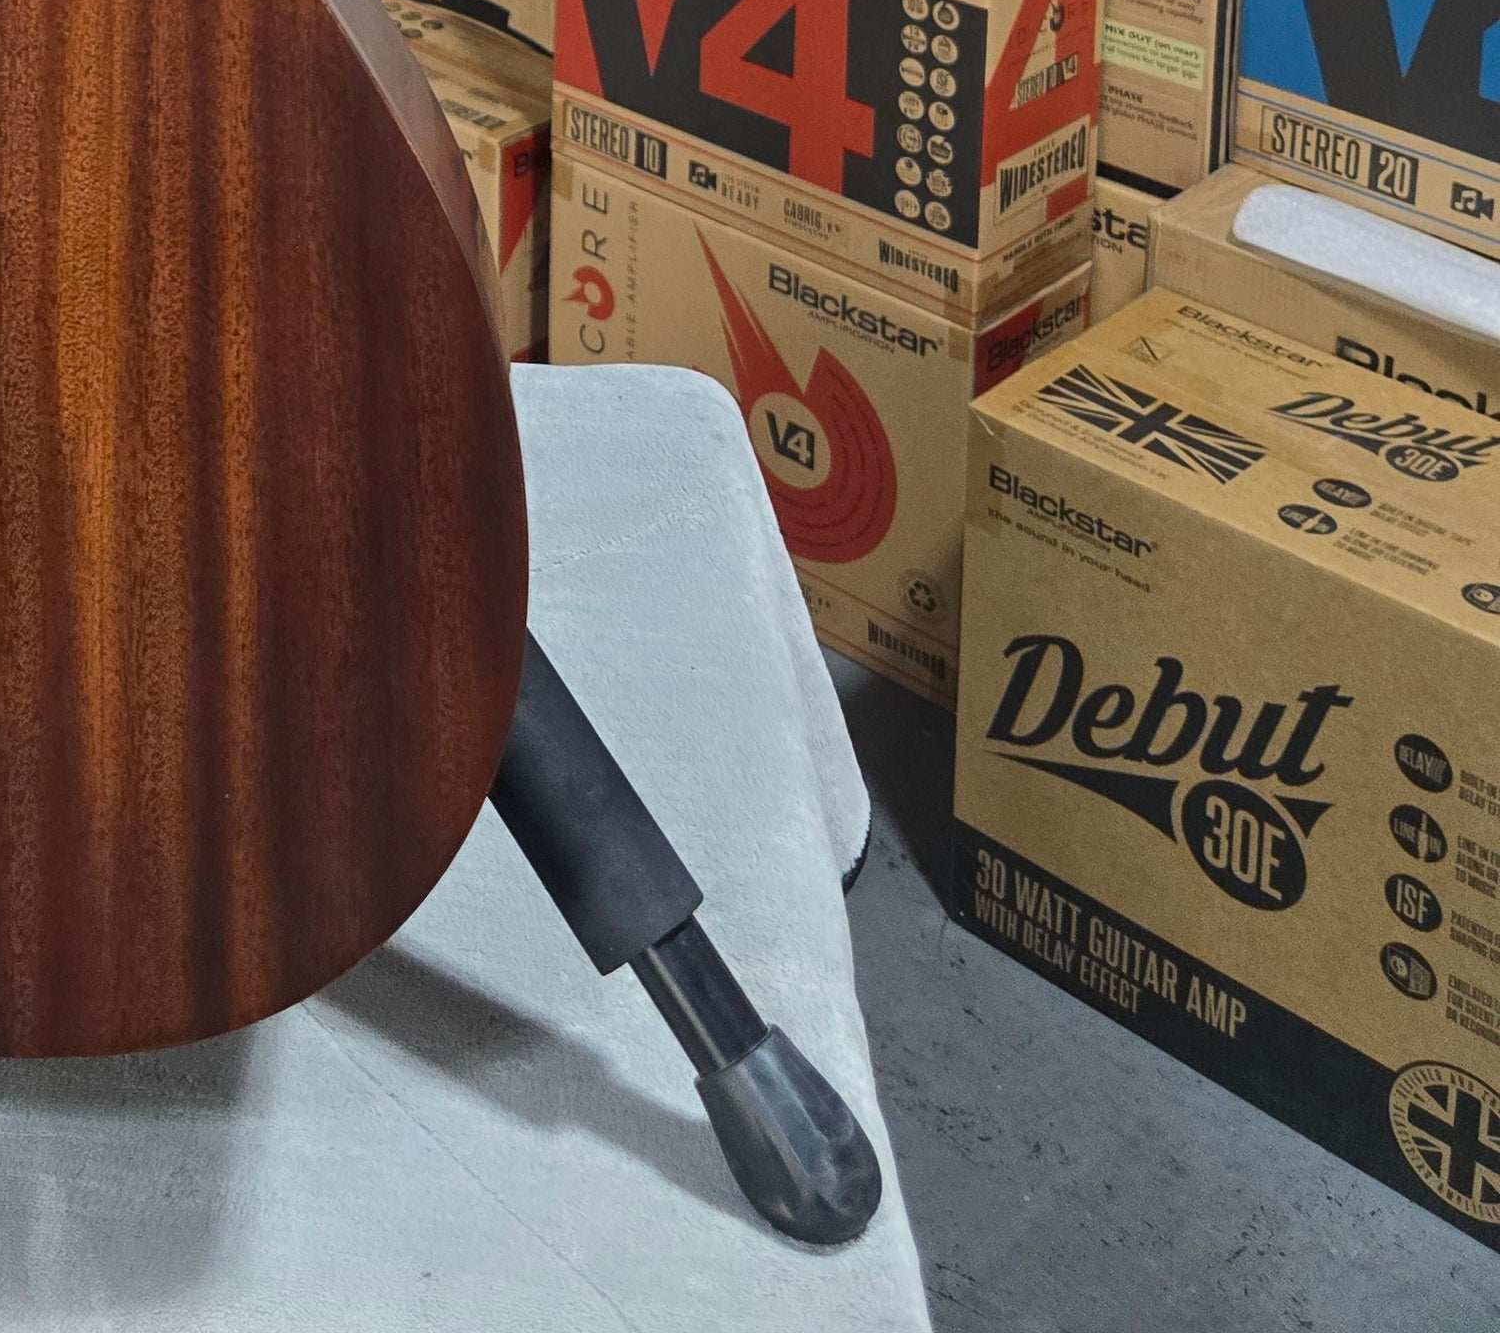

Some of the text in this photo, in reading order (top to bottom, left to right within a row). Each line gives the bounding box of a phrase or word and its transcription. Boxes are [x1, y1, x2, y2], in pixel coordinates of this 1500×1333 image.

[1104, 23, 1125, 37] MIX
[1128, 28, 1152, 45] OUT
[1107, 84, 1144, 104] PHASE
[570, 105, 660, 174] STEREO 10
[999, 124, 1087, 214] WIDESTEREO
[1271, 113, 1412, 200] STEREO 20
[626, 201, 640, 304] AMPLIFIER
[878, 238, 960, 294] WIDESTEREO
[768, 262, 939, 357] Blackstar
[807, 309, 897, 356] AMPLIFICATION
[986, 295, 1085, 373] Blackstar
[1177, 305, 1324, 368] Blackstar
[765, 409, 816, 472] V4
[1267, 391, 1500, 458] Debut
[1395, 447, 1452, 480] 30E
[988, 463, 1153, 559] Blackstar
[1015, 521, 1059, 549] sound
[867, 618, 946, 681] WIDESTEREO
[986, 634, 1355, 787] Debut
[1203, 794, 1287, 902] 30E
[1396, 878, 1431, 925] ISF
[974, 889, 1141, 1016] WITH DELAY EFFECT
[975, 848, 1247, 1039] 30 WATT GUITAR AMP
